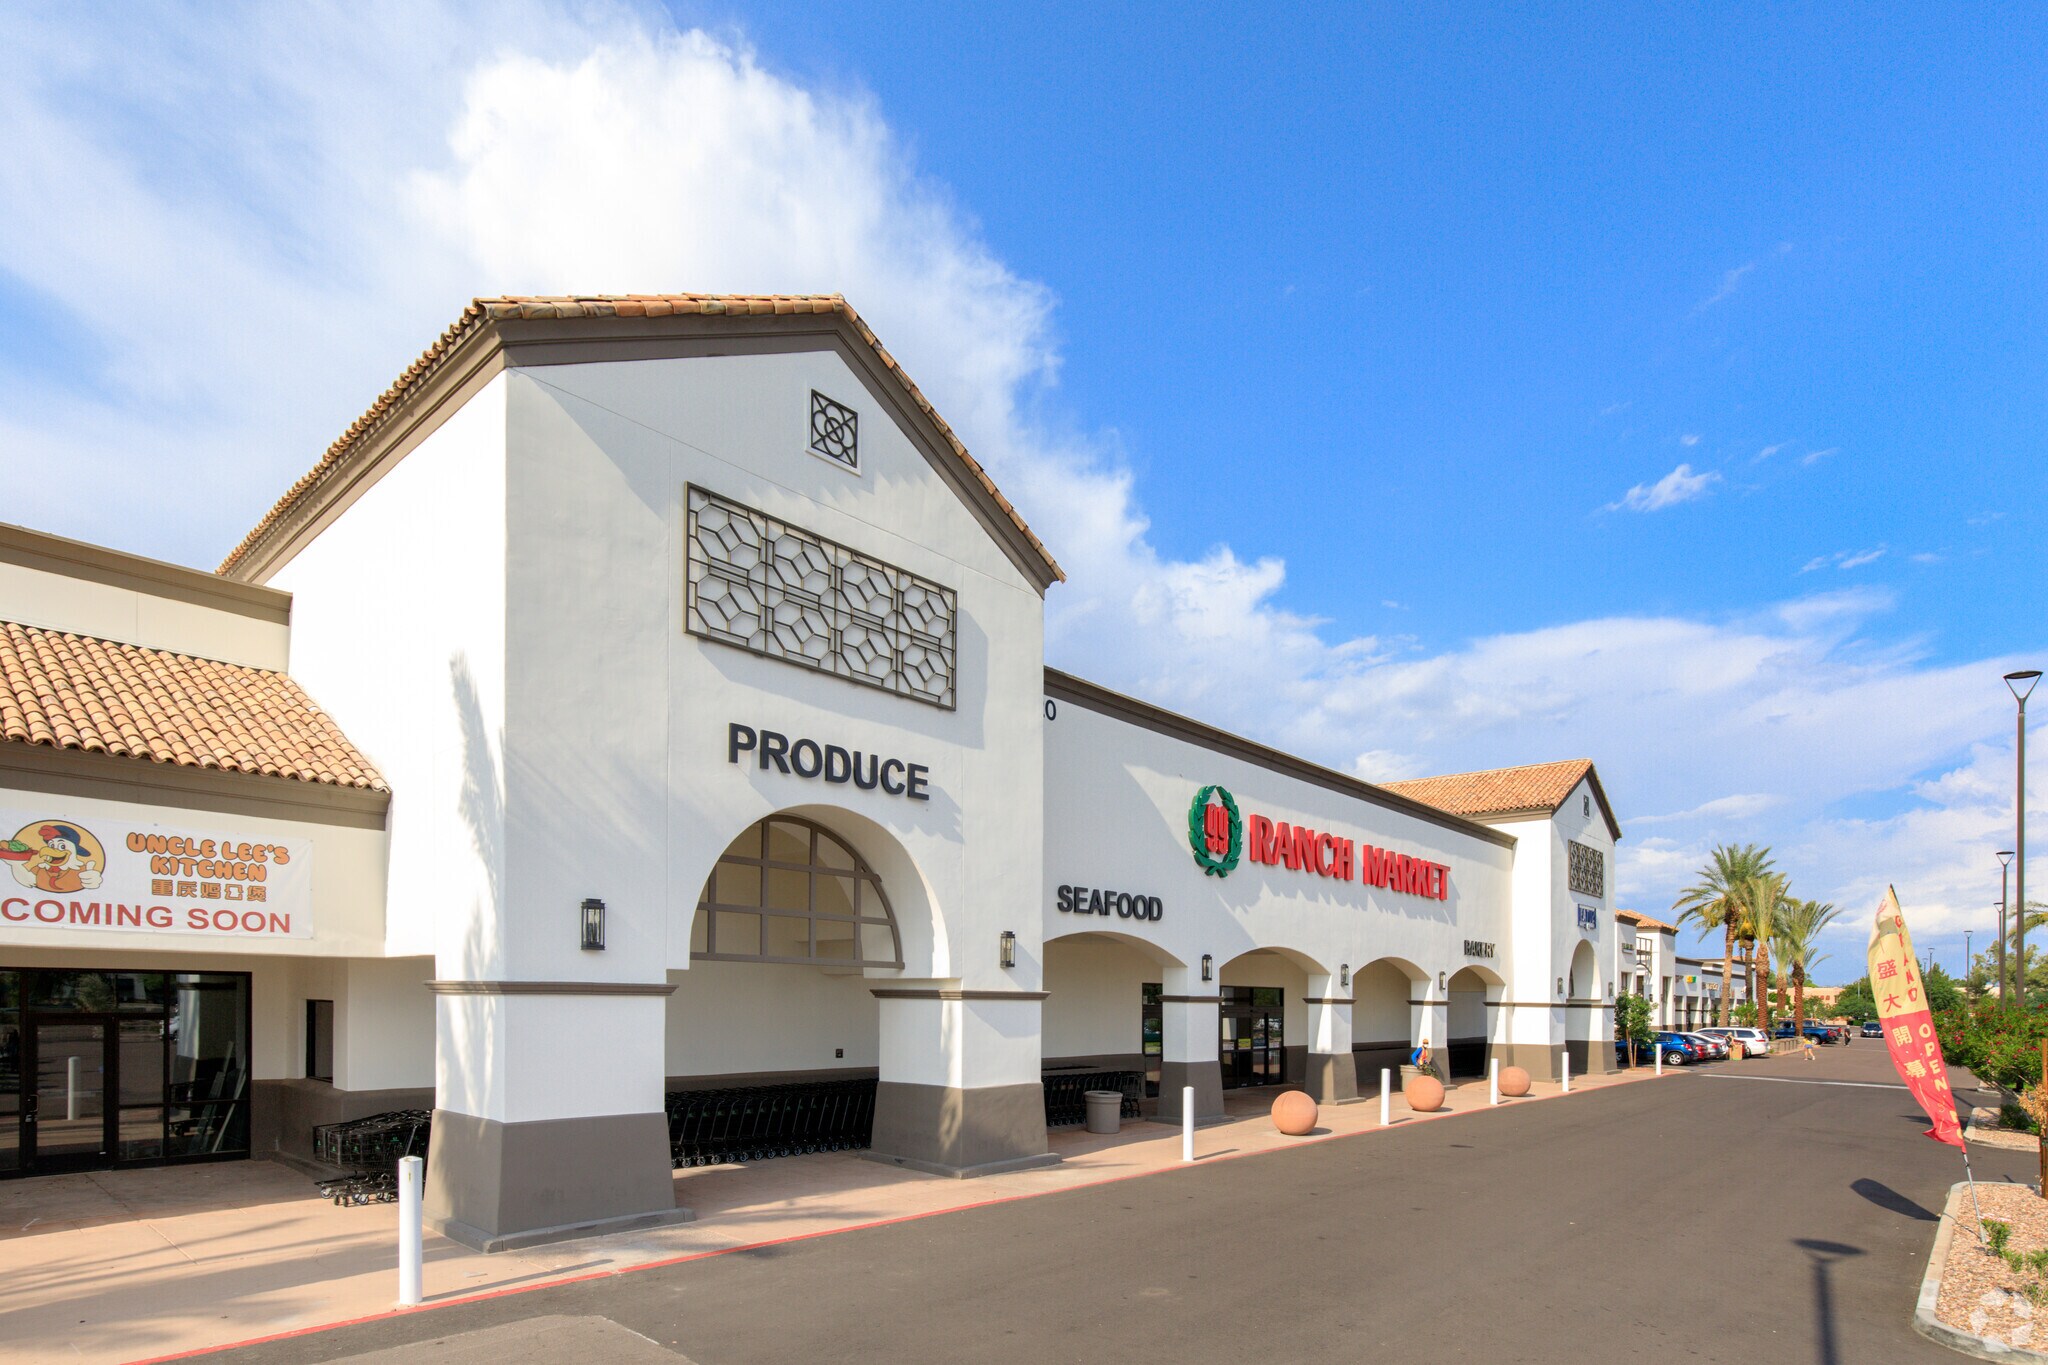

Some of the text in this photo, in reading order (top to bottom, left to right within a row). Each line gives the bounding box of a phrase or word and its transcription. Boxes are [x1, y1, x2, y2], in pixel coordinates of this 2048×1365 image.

[728, 722, 930, 801] PRODUCE
[126, 832, 291, 865] UNCLE LEE'S
[1204, 803, 1451, 900] 99 RANCH MARKET
[150, 855, 267, 882] KITCHEN
[151, 879, 267, 902] 重庆鸡公煲
[1057, 884, 1163, 921] SEAFOOD
[1, 897, 290, 933] COMING SOON
[1464, 939, 1496, 958] BAKERY
[1877, 959, 1927, 1078] 盛大開幕
